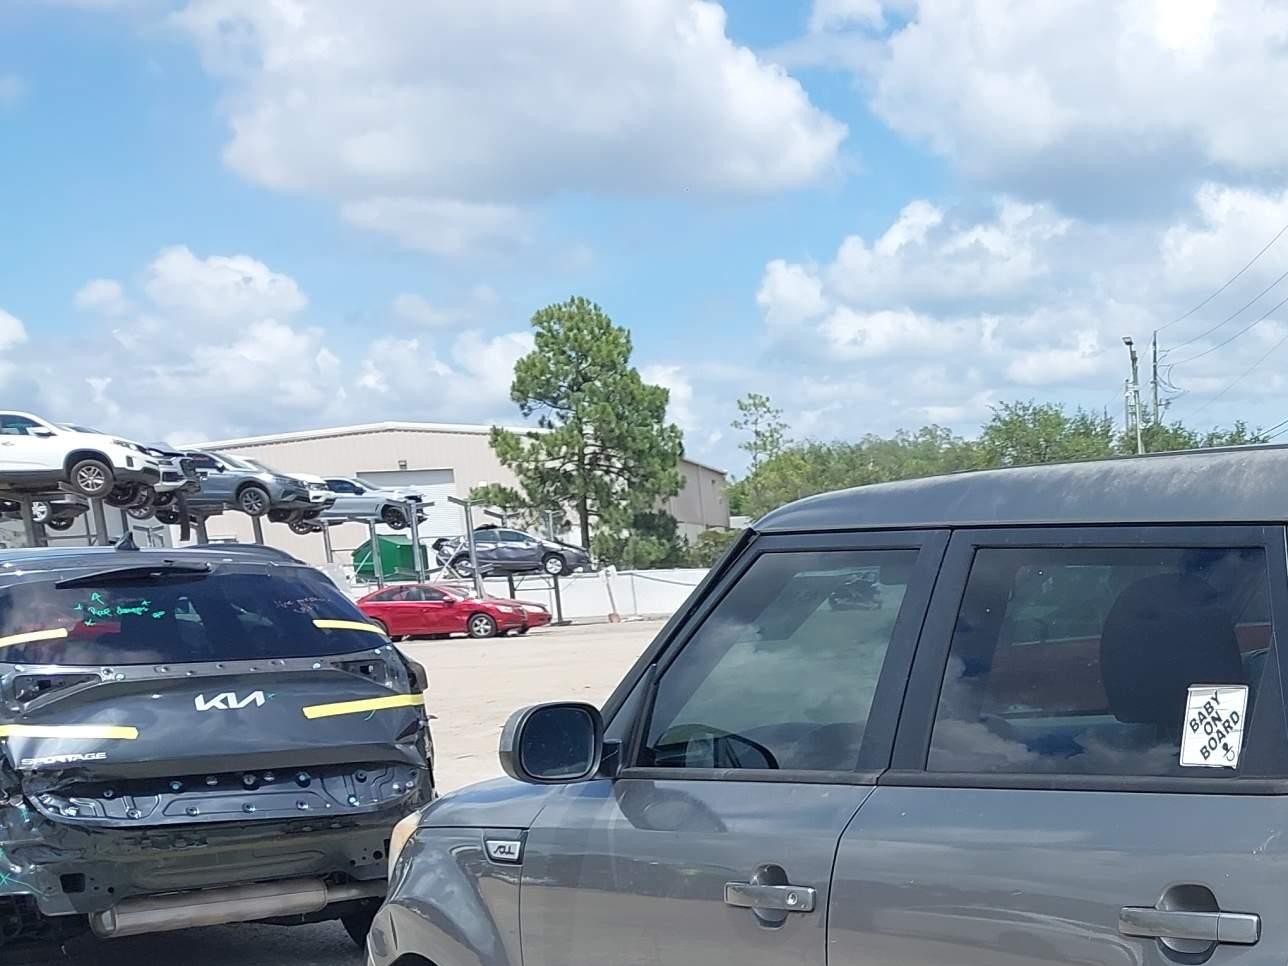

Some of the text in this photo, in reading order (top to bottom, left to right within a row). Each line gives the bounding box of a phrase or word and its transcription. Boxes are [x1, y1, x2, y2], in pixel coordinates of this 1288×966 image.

[194, 690, 266, 711] KIA
[1189, 690, 1221, 734] BABY
[1199, 710, 1240, 761] BOARD
[1203, 711, 1223, 736] ON
[20, 752, 107, 766] SPORTAGE
